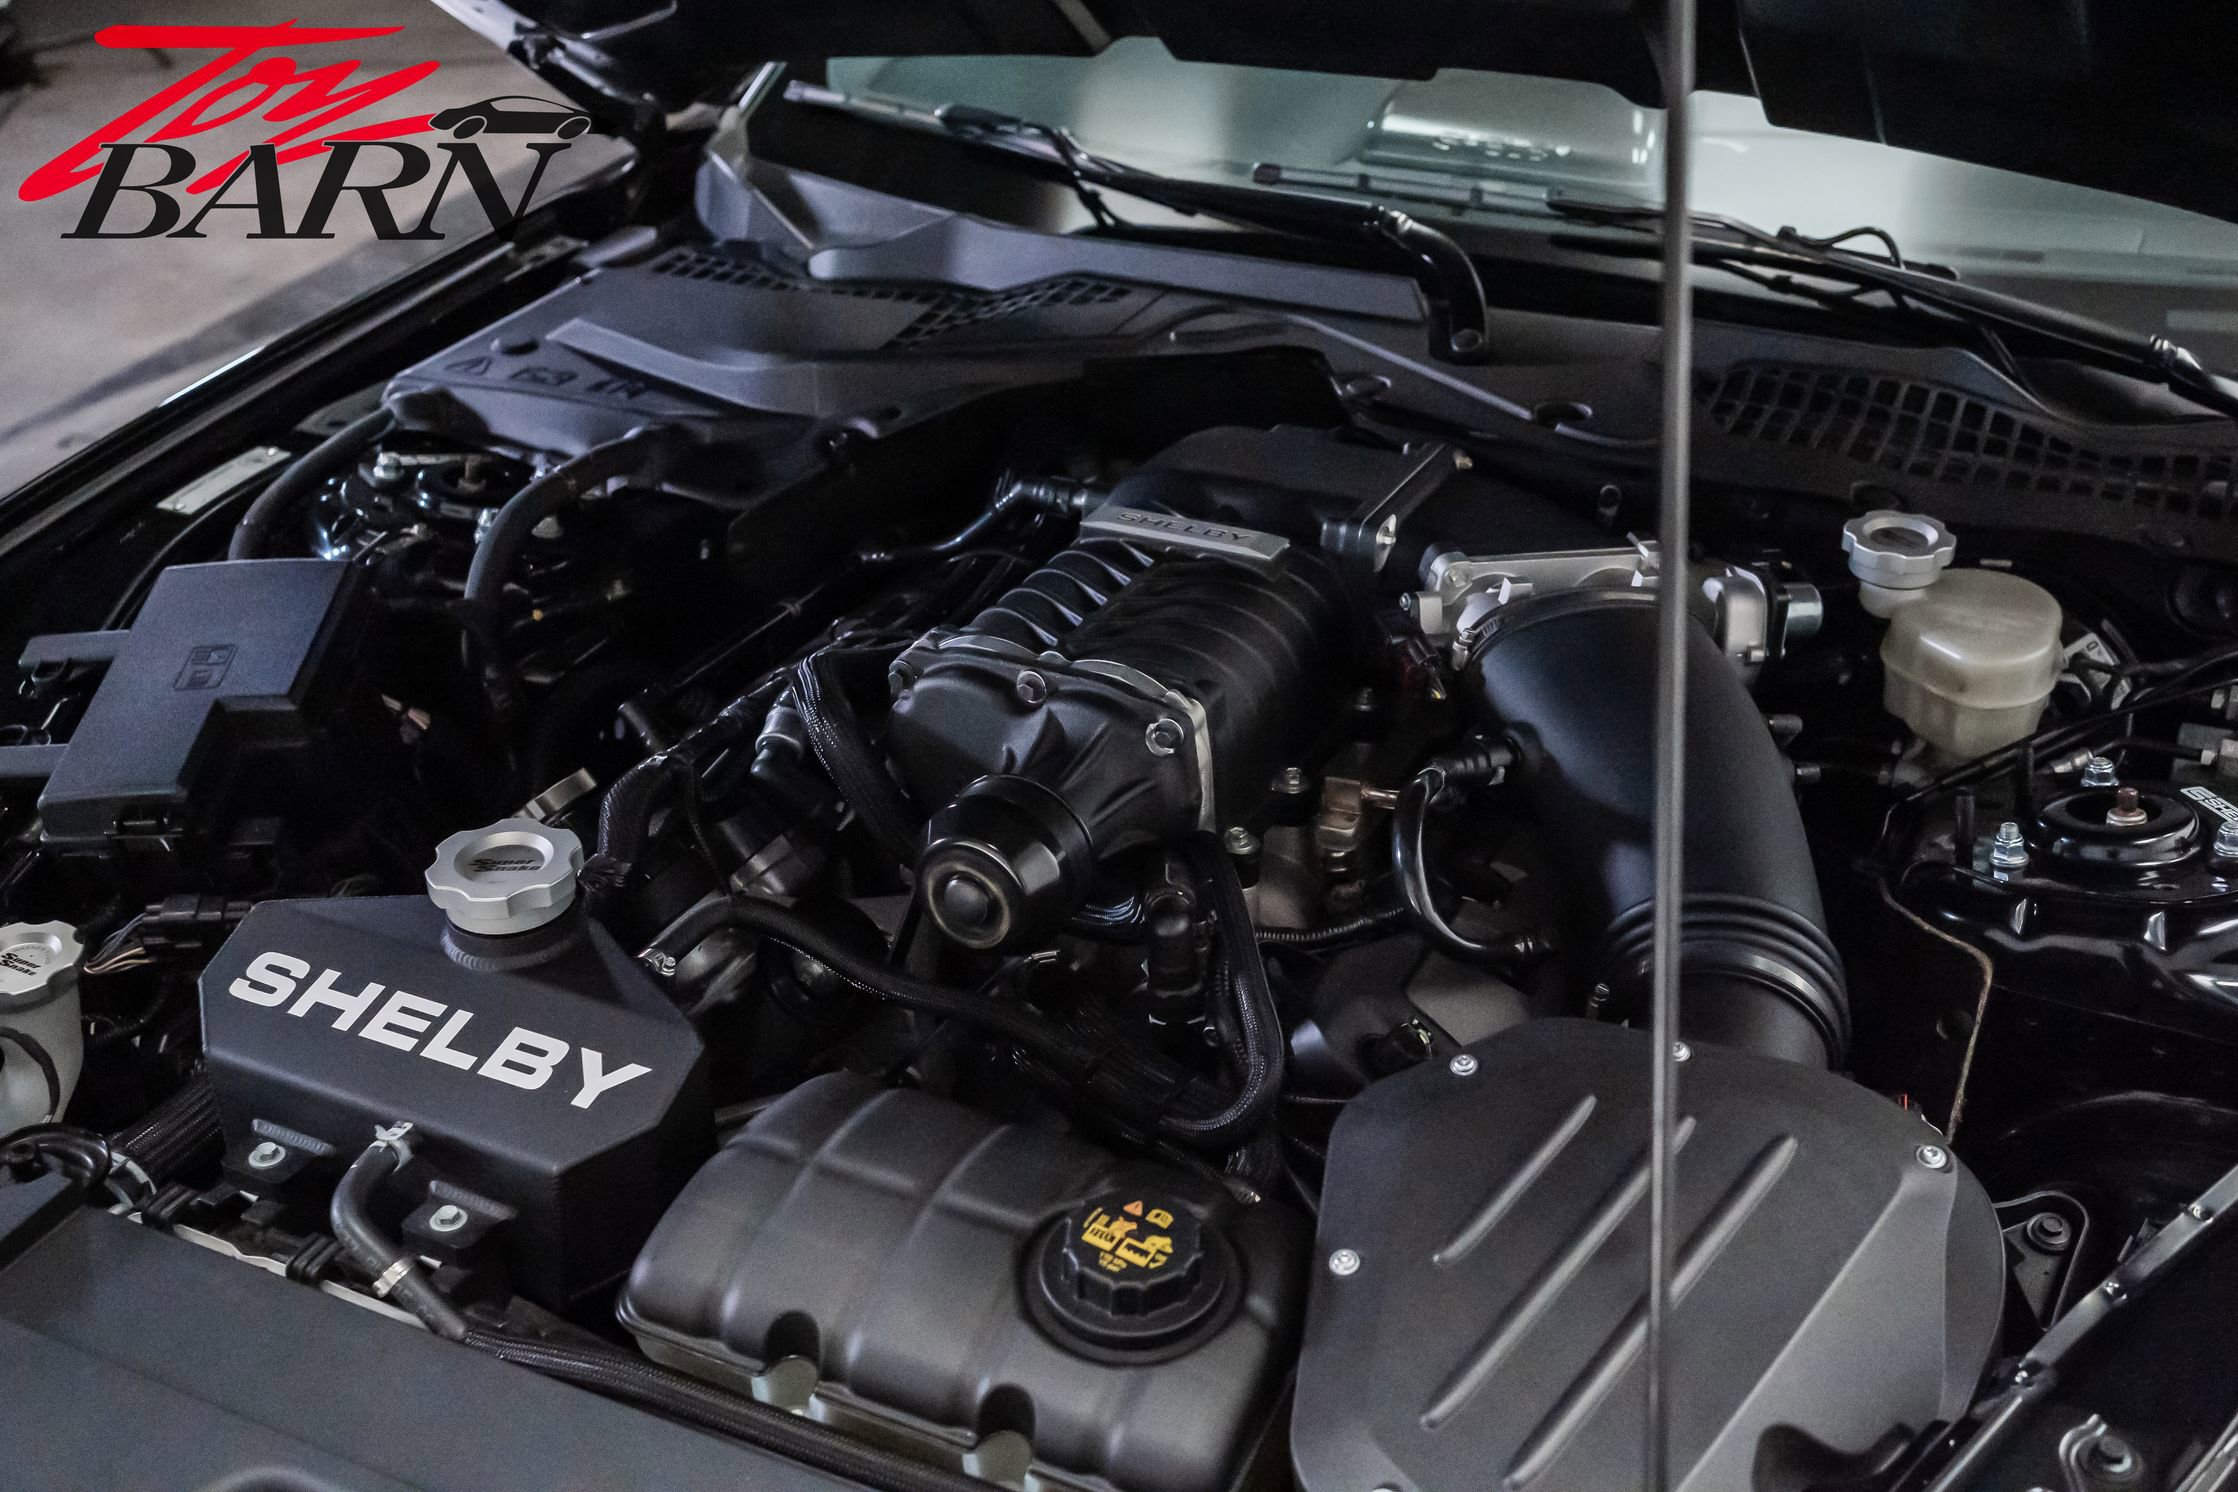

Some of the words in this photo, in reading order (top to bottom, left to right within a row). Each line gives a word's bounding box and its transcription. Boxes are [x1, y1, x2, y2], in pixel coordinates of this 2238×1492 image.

[1116, 512, 1252, 541] SHELBY
[473, 864, 542, 872] Snake
[0, 952, 42, 969] Super
[228, 951, 653, 1110] SHELBY
